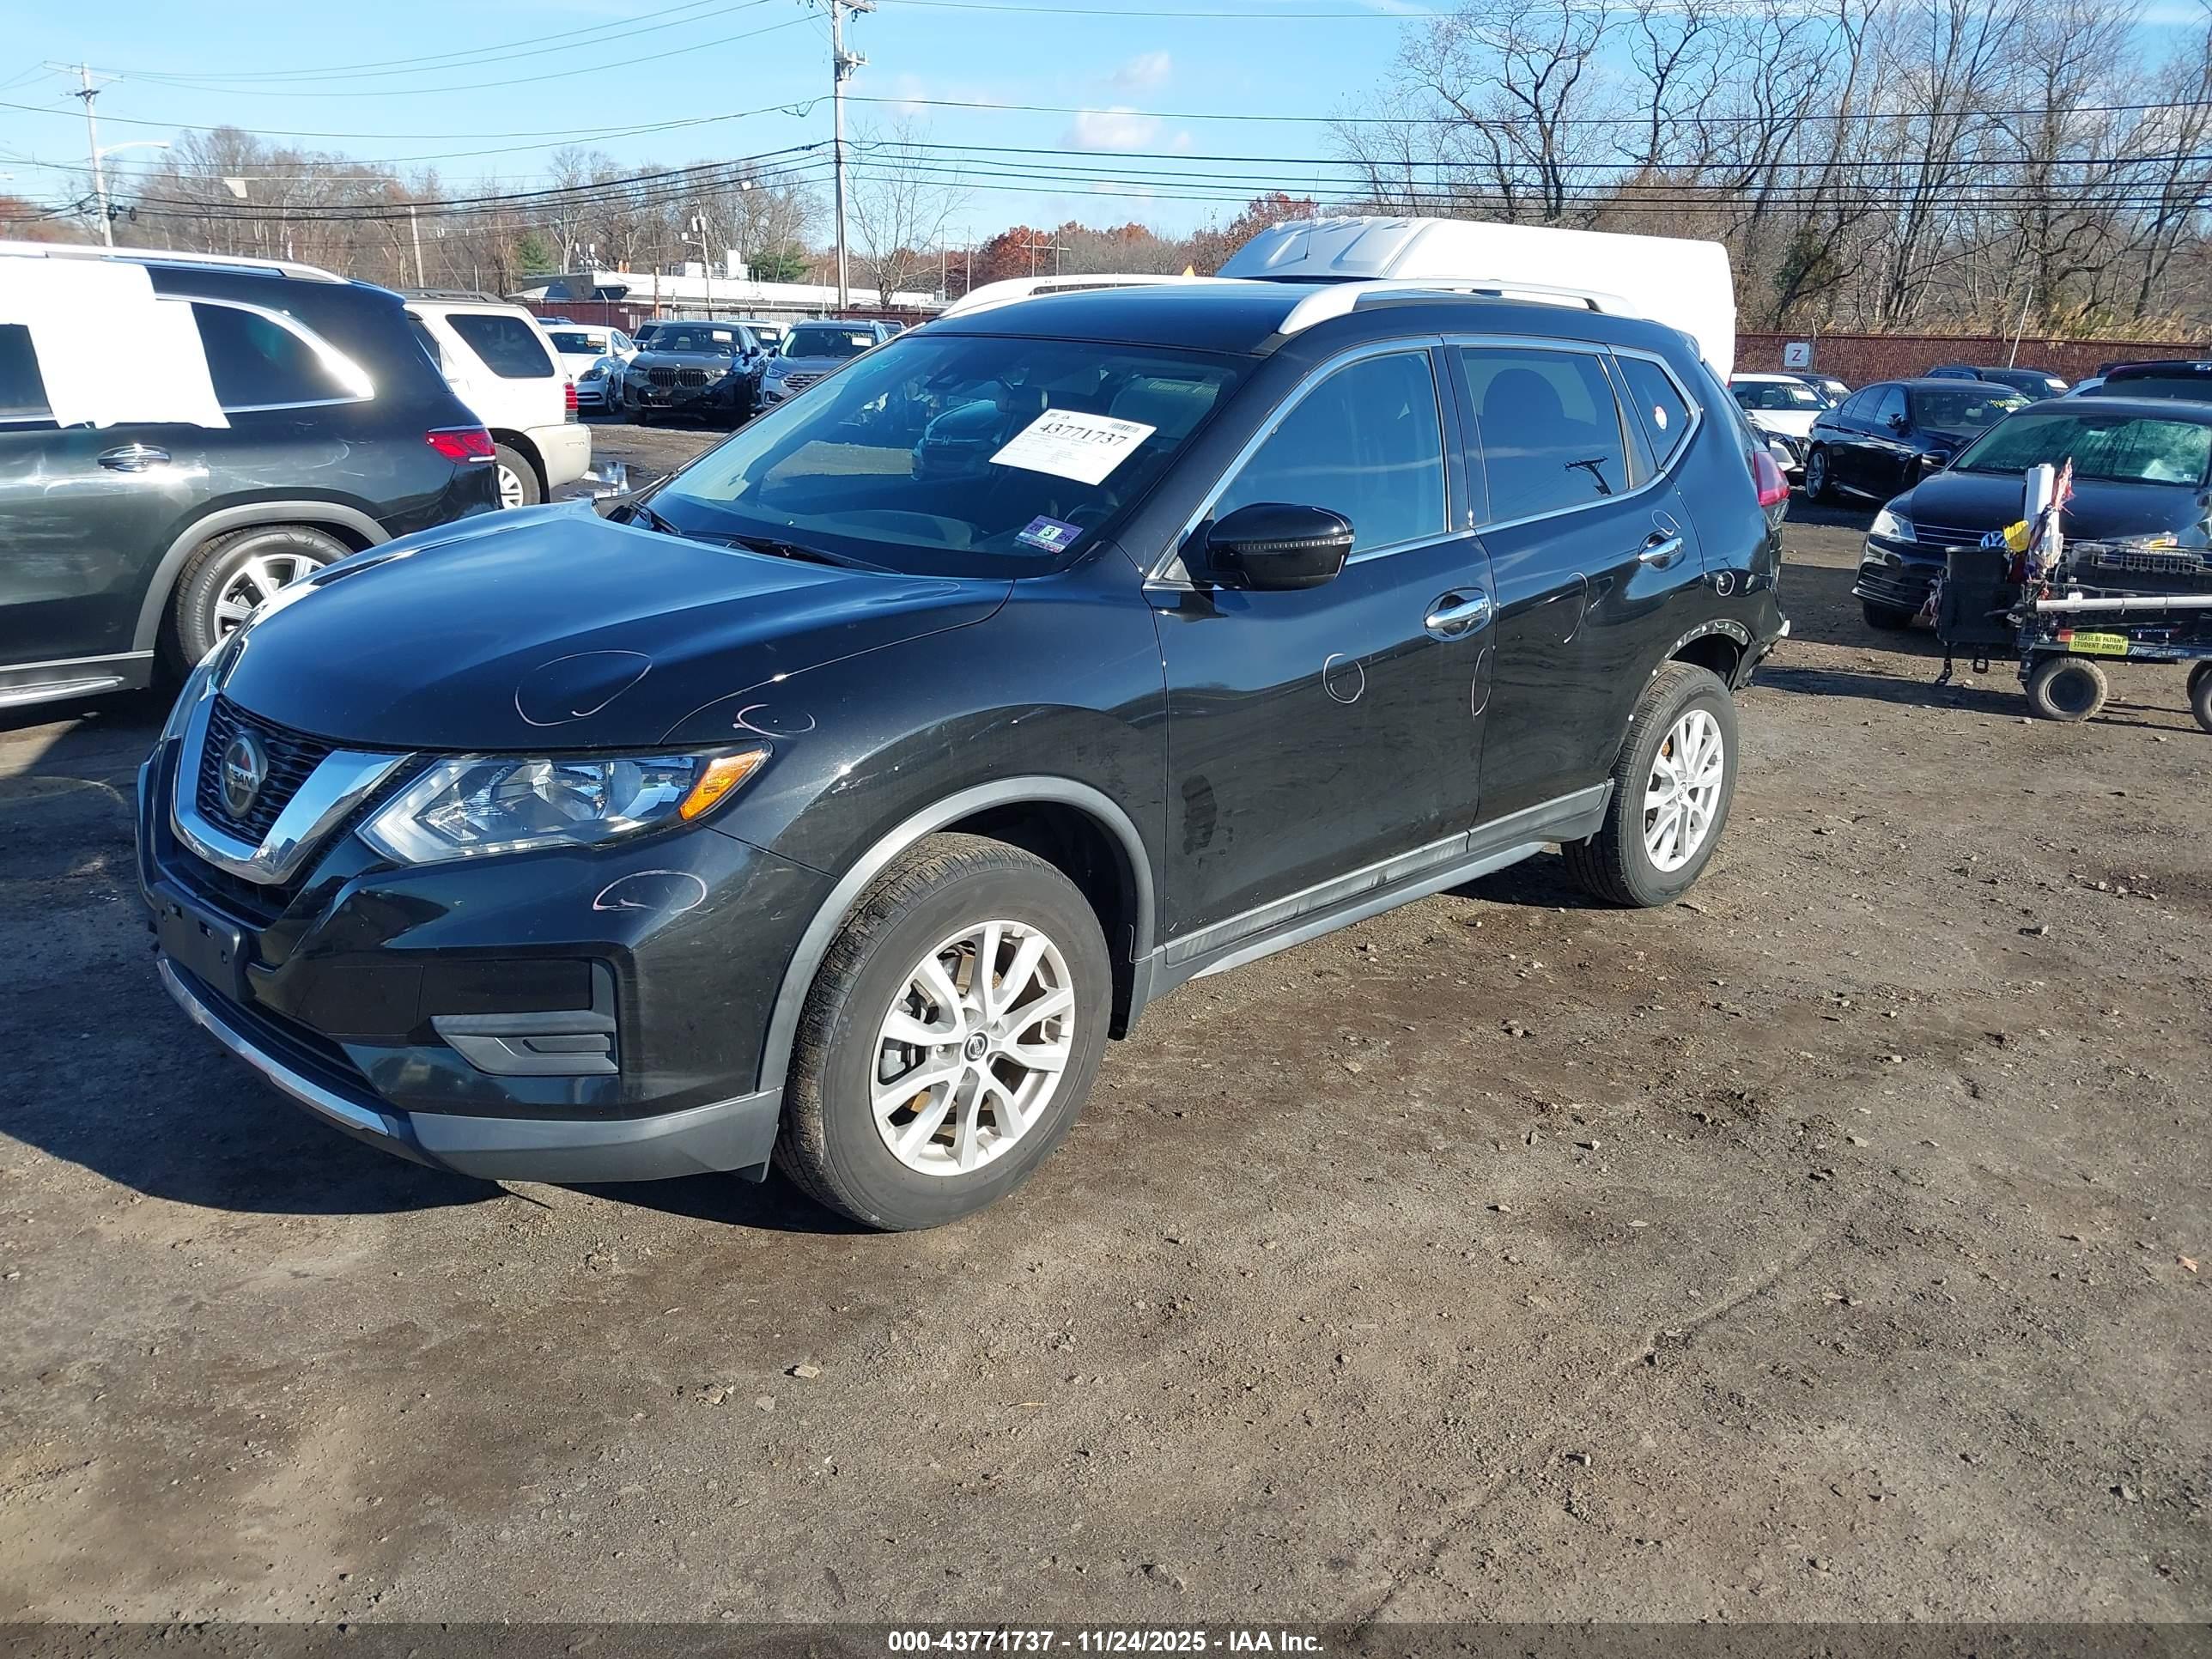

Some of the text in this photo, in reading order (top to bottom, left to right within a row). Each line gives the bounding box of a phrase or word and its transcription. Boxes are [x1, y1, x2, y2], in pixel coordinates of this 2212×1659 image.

[1792, 350, 1802, 361] Z
[1040, 422, 1128, 447] 43771737
[1043, 527, 1055, 537] 3
[1059, 533, 1073, 542] 26
[2074, 641, 2100, 649] STUDENT
